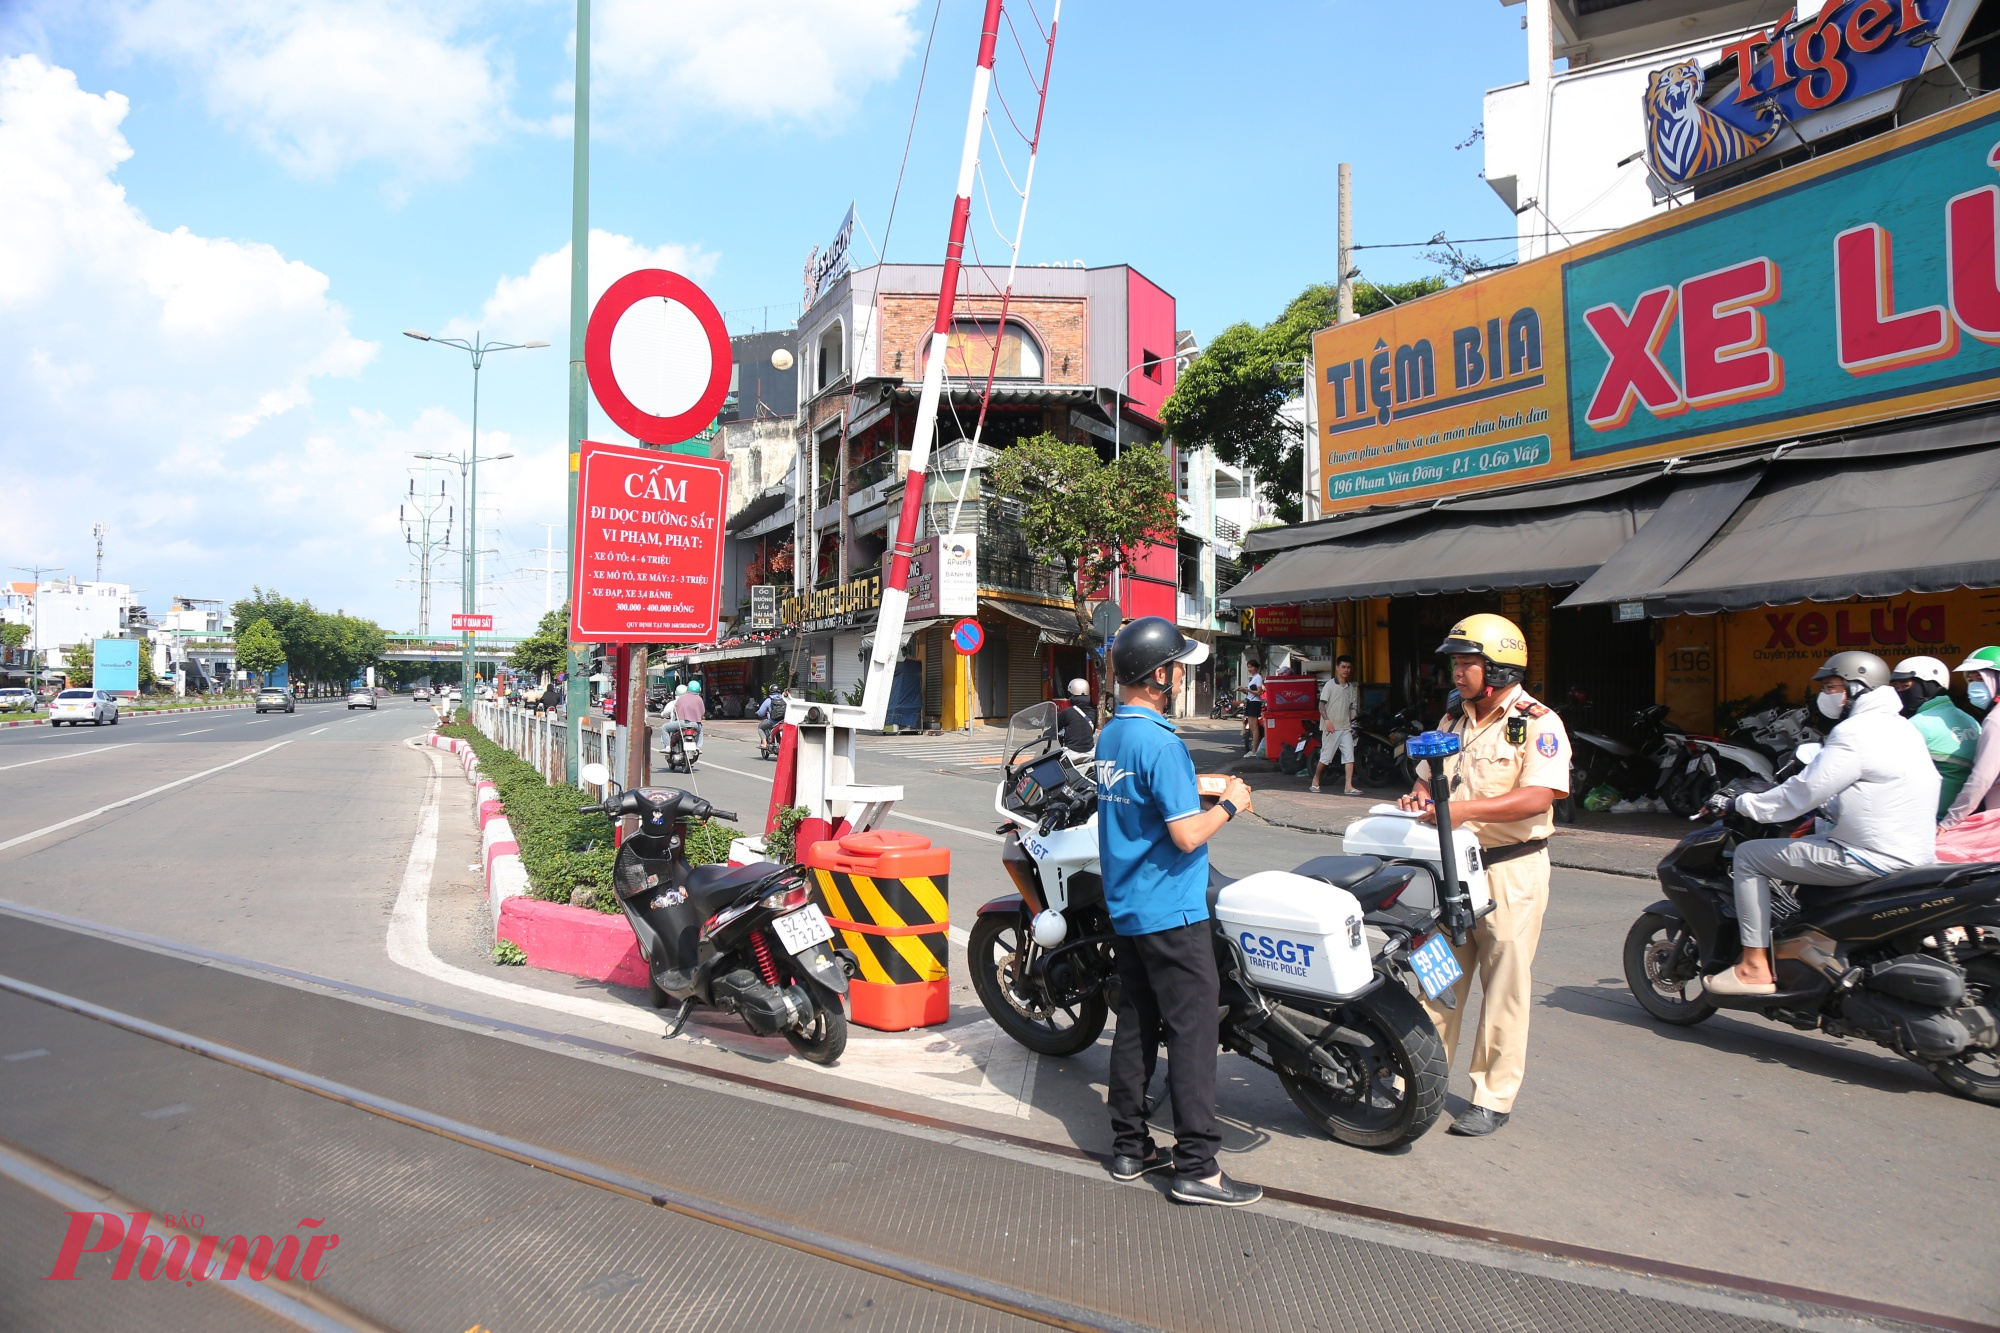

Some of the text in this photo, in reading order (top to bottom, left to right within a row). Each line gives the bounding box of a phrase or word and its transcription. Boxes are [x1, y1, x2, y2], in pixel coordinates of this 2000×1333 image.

[1583, 256, 1785, 432] XE
[1327, 306, 1543, 427] TIỆM BIA
[1328, 450, 1358, 466] Chuyên
[1382, 444, 1394, 456] vụ
[1395, 437, 1410, 452] bia
[1412, 434, 1424, 448] và
[1425, 431, 1440, 446] các
[1442, 427, 1465, 442] món
[1468, 420, 1496, 437] nhậu
[1498, 411, 1523, 430] bình
[1525, 407, 1549, 424] dân
[1334, 478, 1352, 494] 196
[1355, 476, 1385, 491] Phạm
[1388, 471, 1409, 486] Văn
[1412, 466, 1443, 482] Đồng
[1513, 444, 1540, 464] Vấp
[624, 464, 688, 503] CẤM
[590, 505, 714, 529] ĐI DỌC ĐƯỜNG SẮT
[602, 528, 702, 550] VI PHẠM, PHẠT:
[594, 552, 606, 561] XE
[607, 551, 614, 561] Ô
[616, 552, 630, 562] TÔ:
[641, 555, 646, 563] 6
[647, 554, 671, 566] TRIỆU
[593, 570, 604, 579] XE
[606, 570, 620, 580] MÔ
[622, 570, 635, 581] TÔ,
[636, 572, 648, 581] XE
[648, 572, 670, 583] MÁY:
[680, 576, 685, 584] 3
[686, 575, 708, 586] TRIỆU
[592, 588, 604, 596] XE
[605, 588, 624, 599] ĐẠP,
[625, 590, 636, 598] XE
[649, 589, 673, 600] BÁNH:
[872, 576, 879, 607] 2
[616, 603, 641, 612] 300.000
[646, 604, 672, 612] 400.000
[672, 602, 694, 613] ĐỒNG
[452, 616, 462, 627] CHÚ
[482, 617, 492, 627] SÁT
[1668, 652, 1710, 671] 196
[1114, 794, 1130, 804] Service
[790, 924, 826, 948] 7323
[1240, 932, 1314, 967] C.S.G.T
[1414, 938, 1446, 974] 59-A1
[1248, 956, 1308, 978] TRAFFIC POLICE
[1423, 957, 1460, 996] 016.92
